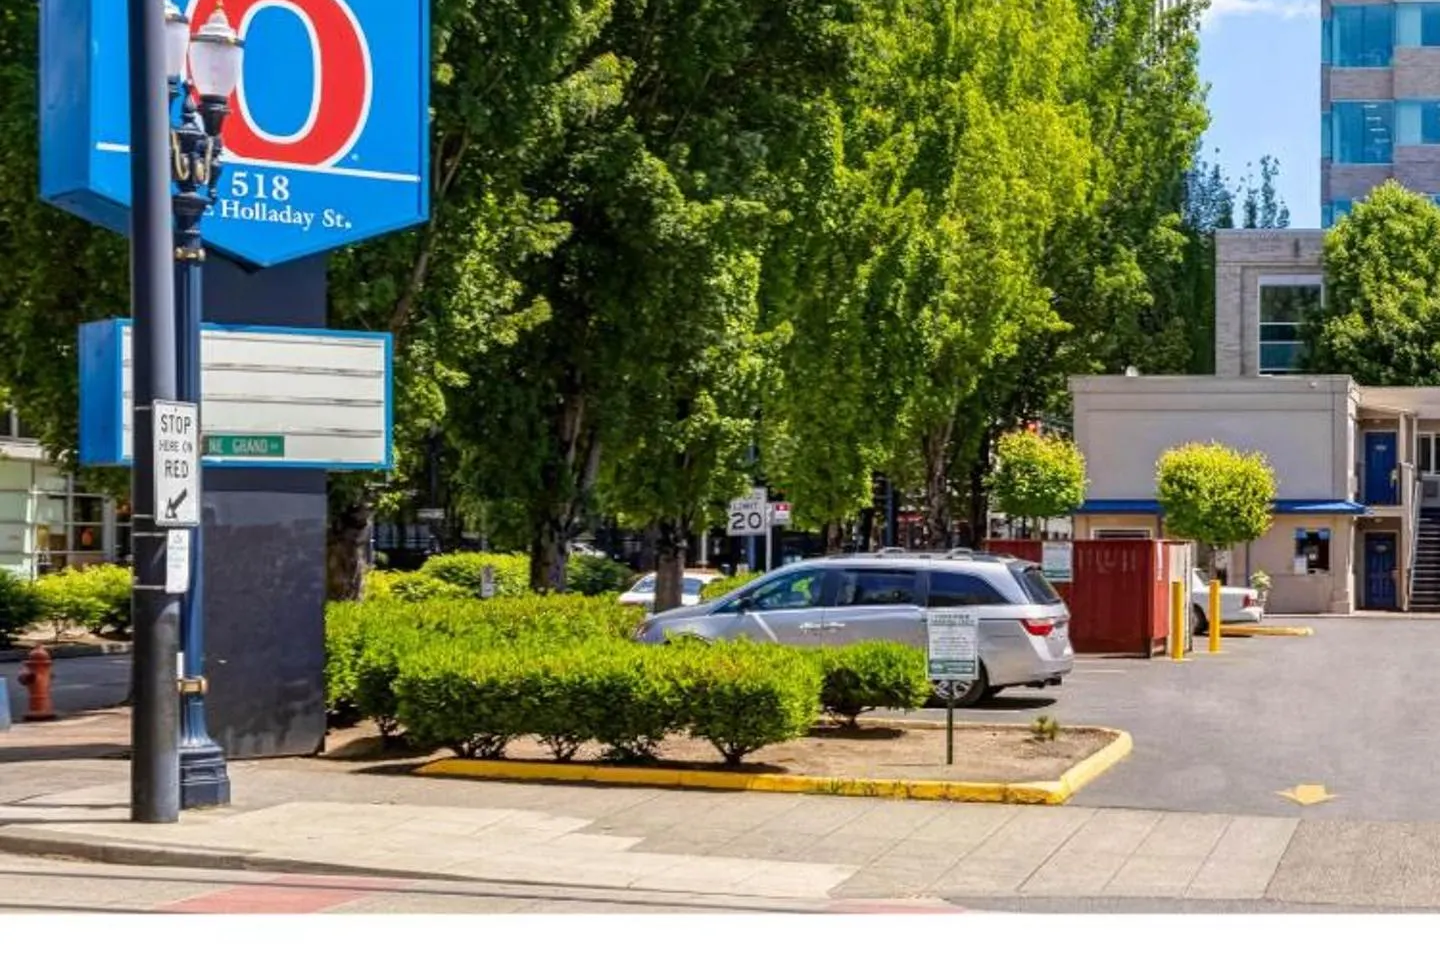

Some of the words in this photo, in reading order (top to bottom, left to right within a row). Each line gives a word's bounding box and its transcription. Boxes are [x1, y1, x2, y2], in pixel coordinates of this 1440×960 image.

[231, 171, 290, 201] 518
[220, 200, 315, 232] Holladay
[322, 208, 353, 230] St.
[161, 414, 191, 435] STOP
[159, 439, 180, 453] HERE
[182, 439, 193, 454] ON
[209, 438, 224, 454] NE
[232, 438, 269, 454] GRAND
[164, 460, 189, 479] RED
[731, 512, 762, 529] 20
